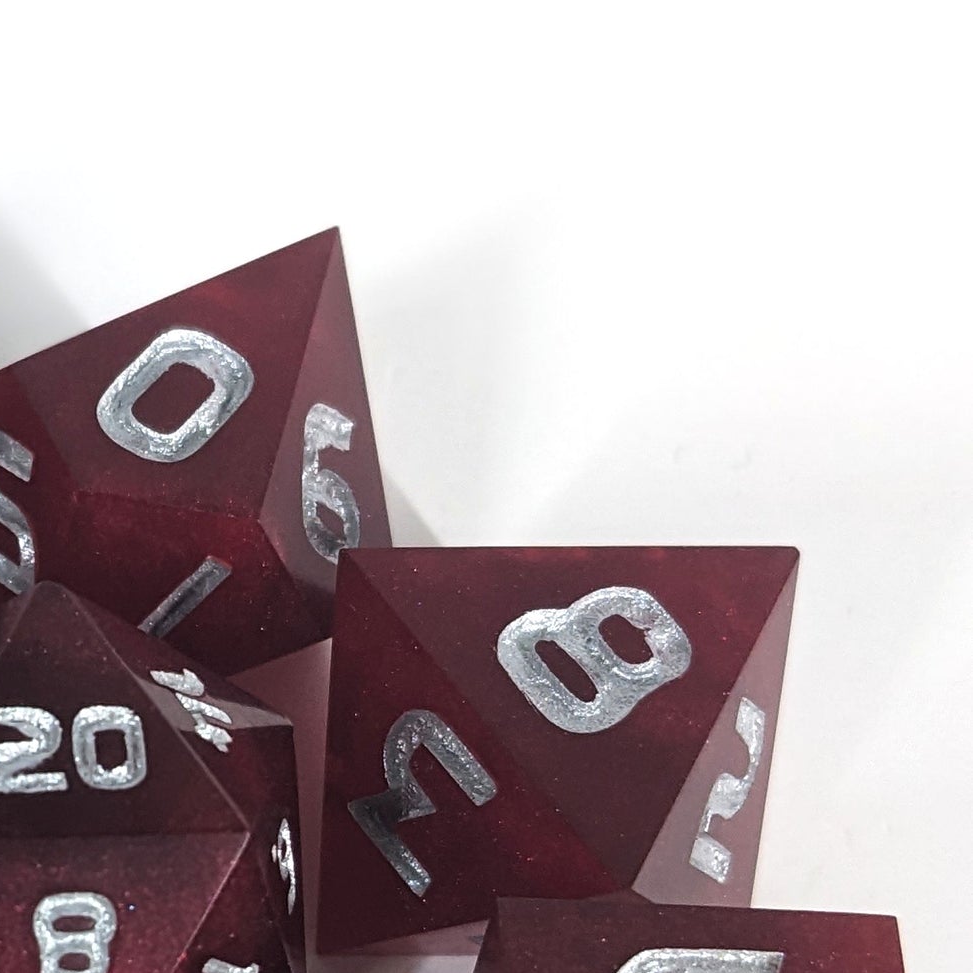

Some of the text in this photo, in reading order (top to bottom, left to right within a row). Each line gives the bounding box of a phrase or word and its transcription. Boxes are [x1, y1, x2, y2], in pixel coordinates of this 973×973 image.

[96, 327, 255, 463] 0
[150, 668, 233, 753] 14
[497, 586, 692, 733] 8
[347, 709, 498, 898] 3
